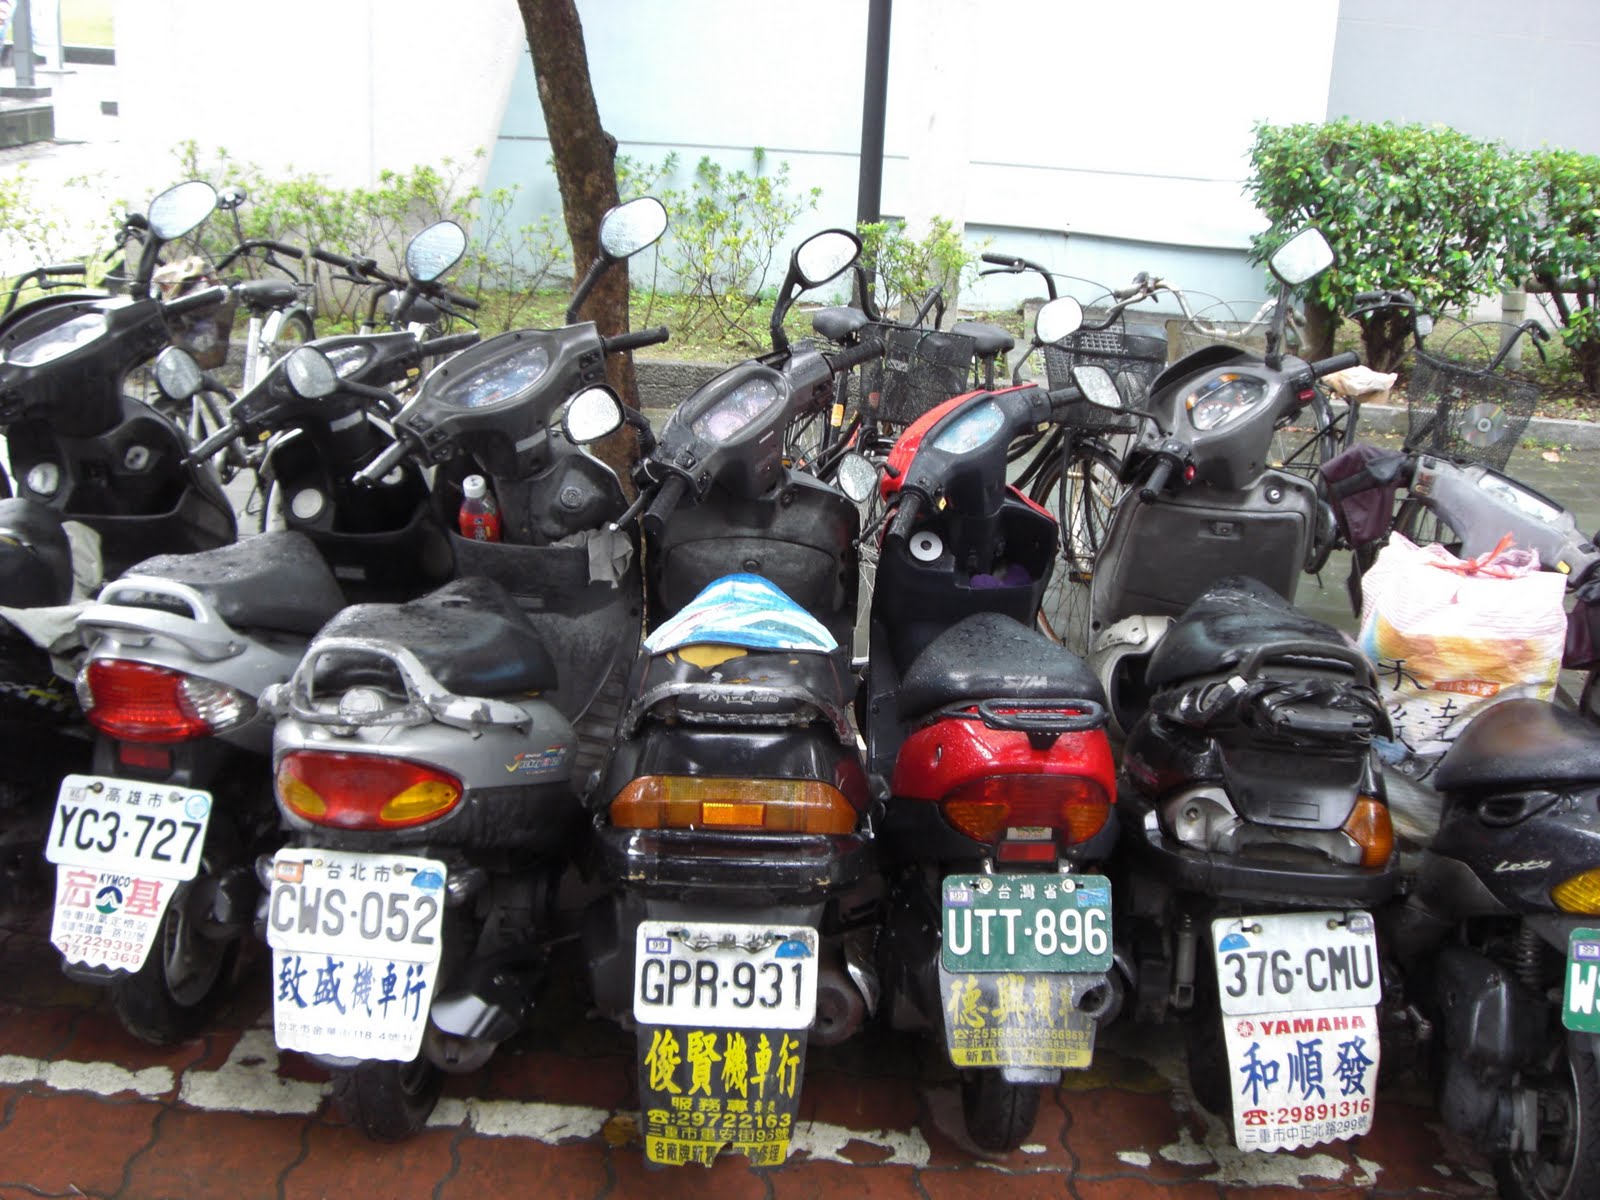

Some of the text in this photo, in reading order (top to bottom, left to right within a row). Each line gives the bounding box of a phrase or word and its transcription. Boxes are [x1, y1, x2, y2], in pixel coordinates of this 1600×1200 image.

[105, 786, 163, 808] 高雄市
[99, 873, 130, 887] KYMCO
[327, 861, 391, 882] 台北市
[998, 883, 1057, 900] 台灣省
[652, 941, 665, 950] 99
[278, 956, 426, 1021] 致盛機車行
[1570, 963, 1600, 1014] W
[1260, 1016, 1366, 1036] YAMAHA
[644, 1029, 800, 1098] 俊賢機車行
[1239, 1035, 1375, 1106] 和順發
